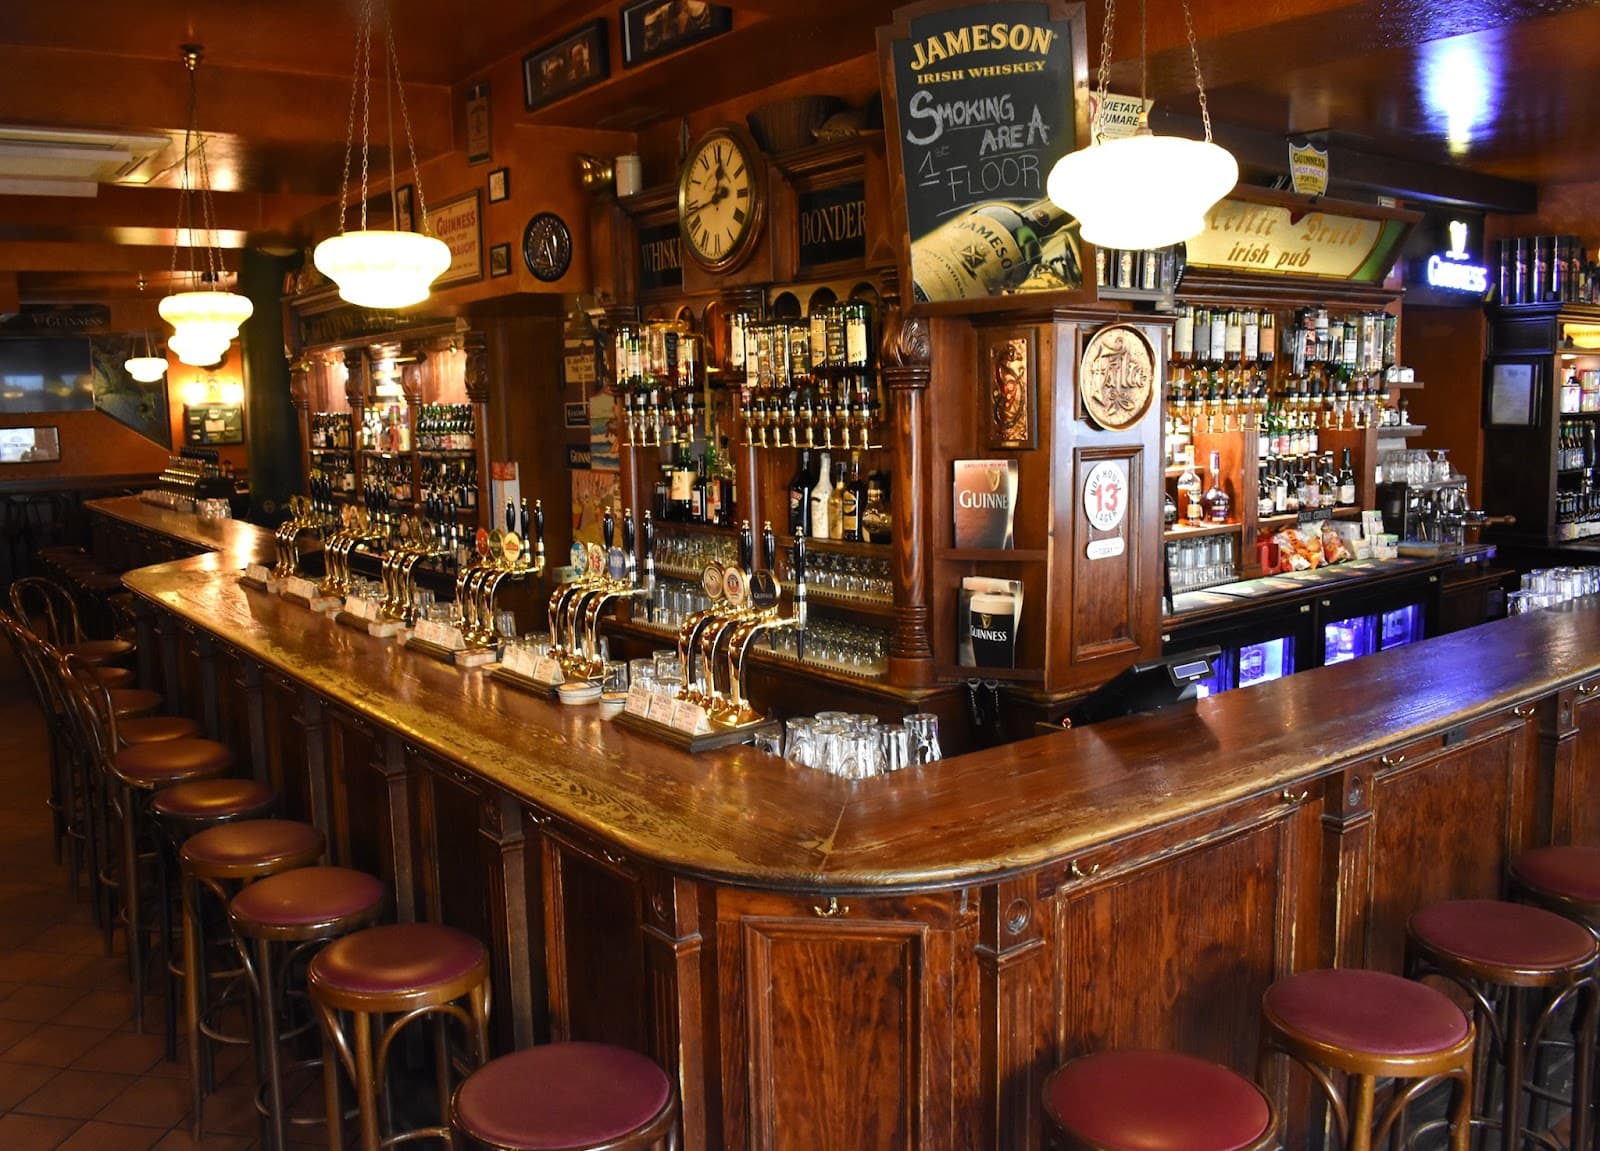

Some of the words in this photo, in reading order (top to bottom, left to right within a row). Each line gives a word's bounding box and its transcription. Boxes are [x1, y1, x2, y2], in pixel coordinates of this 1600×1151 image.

[910, 23, 1053, 71] JAMESON
[917, 70, 964, 85] IRISH
[968, 60, 1047, 80] WHISKEY
[979, 104, 1050, 156] AREA
[1104, 112, 1139, 126] UMARE
[1293, 152, 1326, 169] GUINNESS
[946, 155, 1040, 201] FLOOR
[436, 209, 477, 237] GUINNESS
[1227, 242, 1269, 264] irish
[1274, 247, 1312, 269] pub
[1090, 474, 1101, 496] HOP
[1096, 482, 1119, 512] 13
[1096, 508, 1118, 523] LAGER
[970, 624, 1008, 642] GUINNESS
